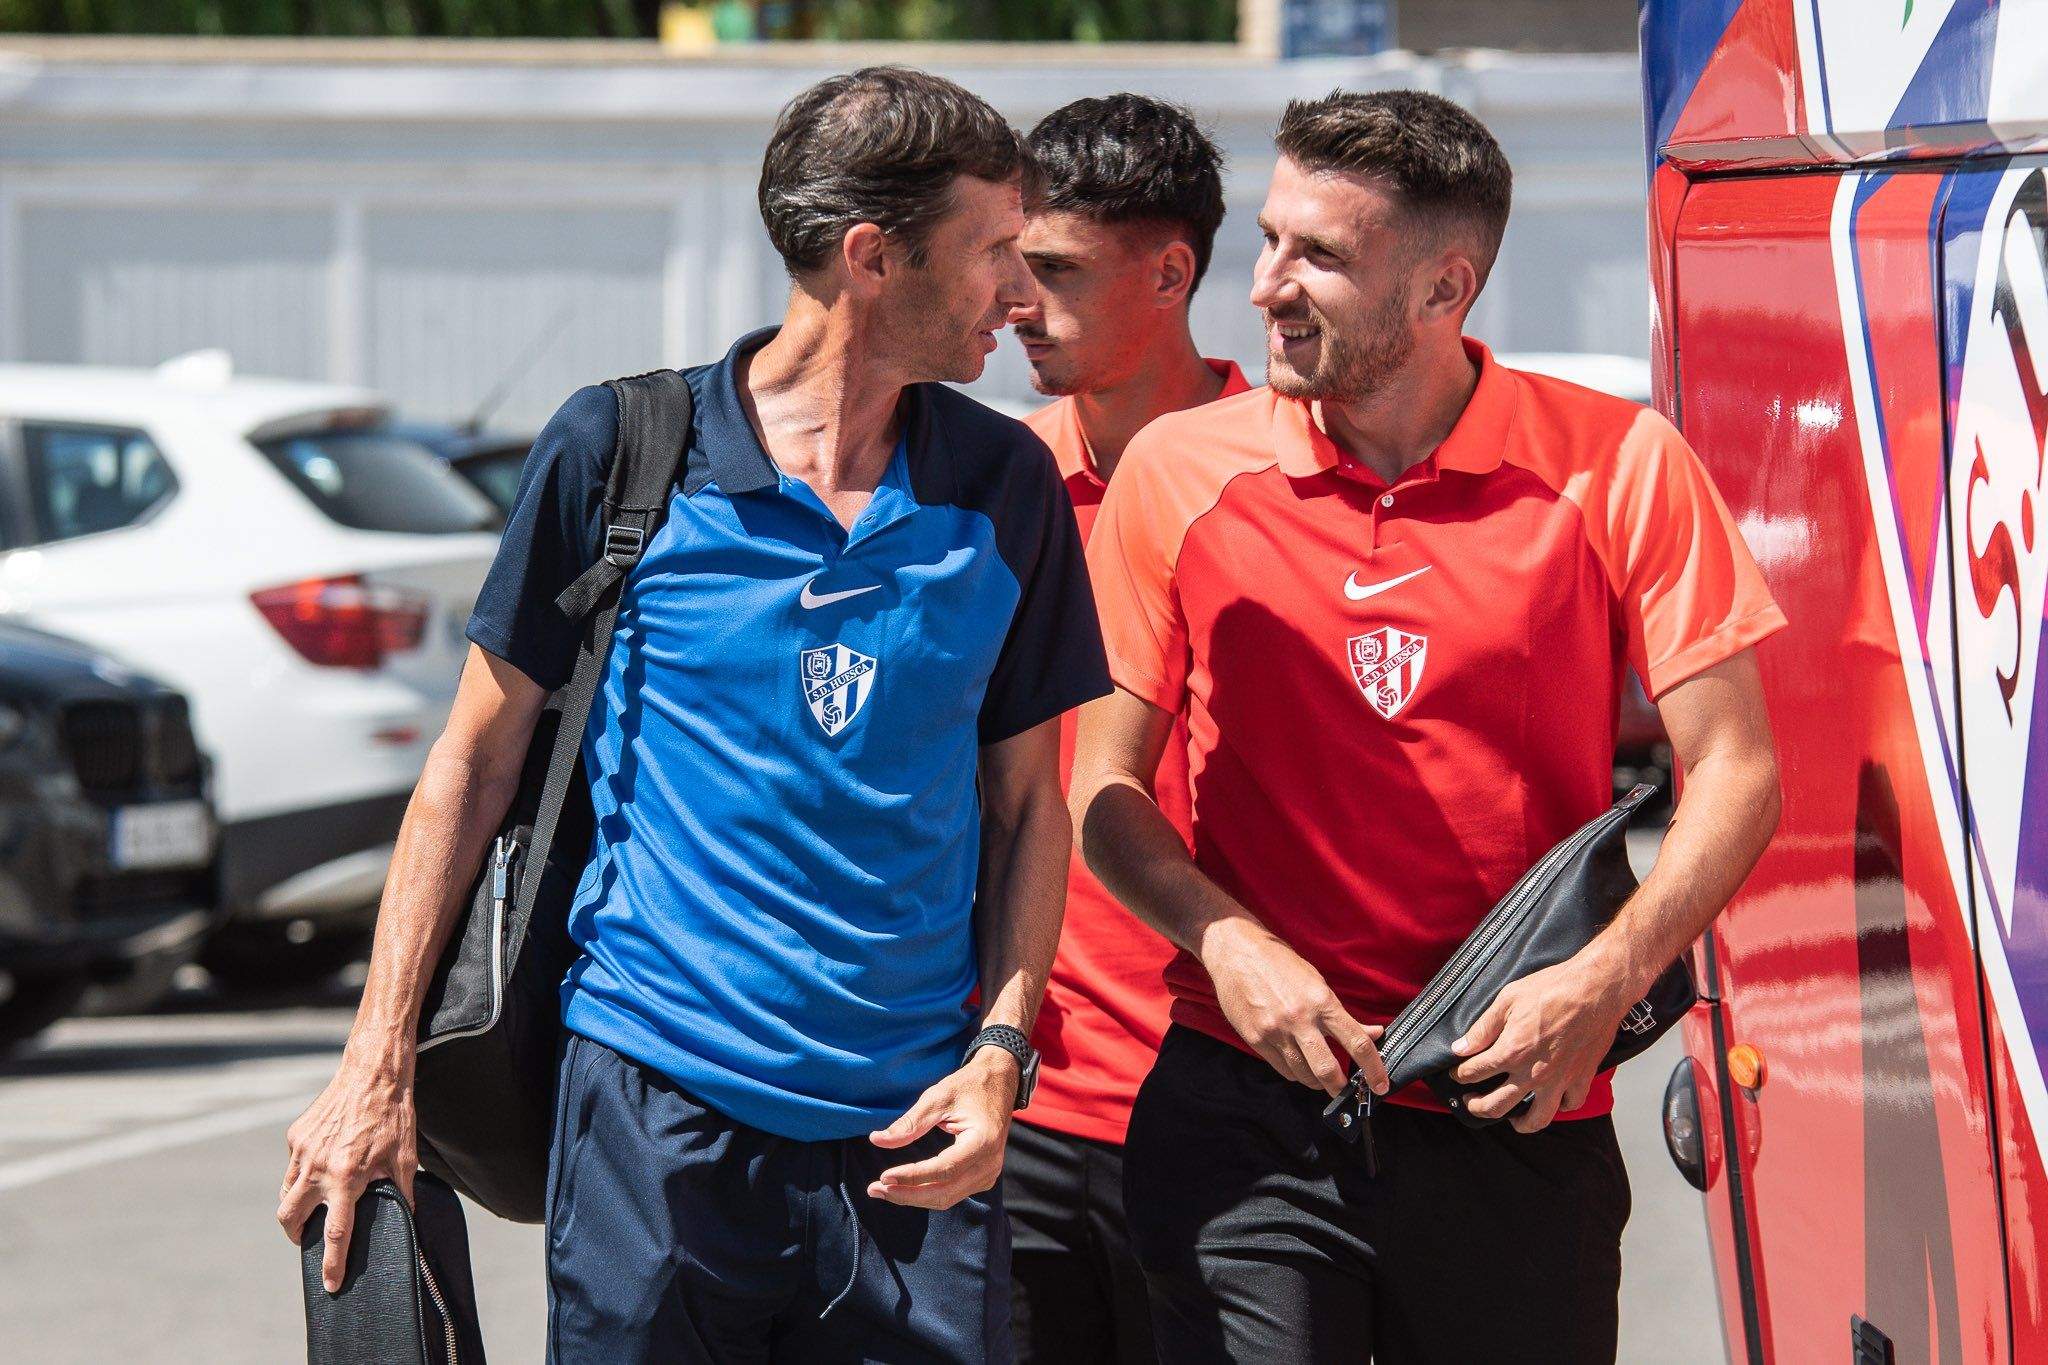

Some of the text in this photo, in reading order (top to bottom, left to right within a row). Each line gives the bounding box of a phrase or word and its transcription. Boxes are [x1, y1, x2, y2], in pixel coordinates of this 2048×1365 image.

[1382, 642, 1421, 671] HUESCA
[812, 662, 871, 700] S.D. HUESCA
